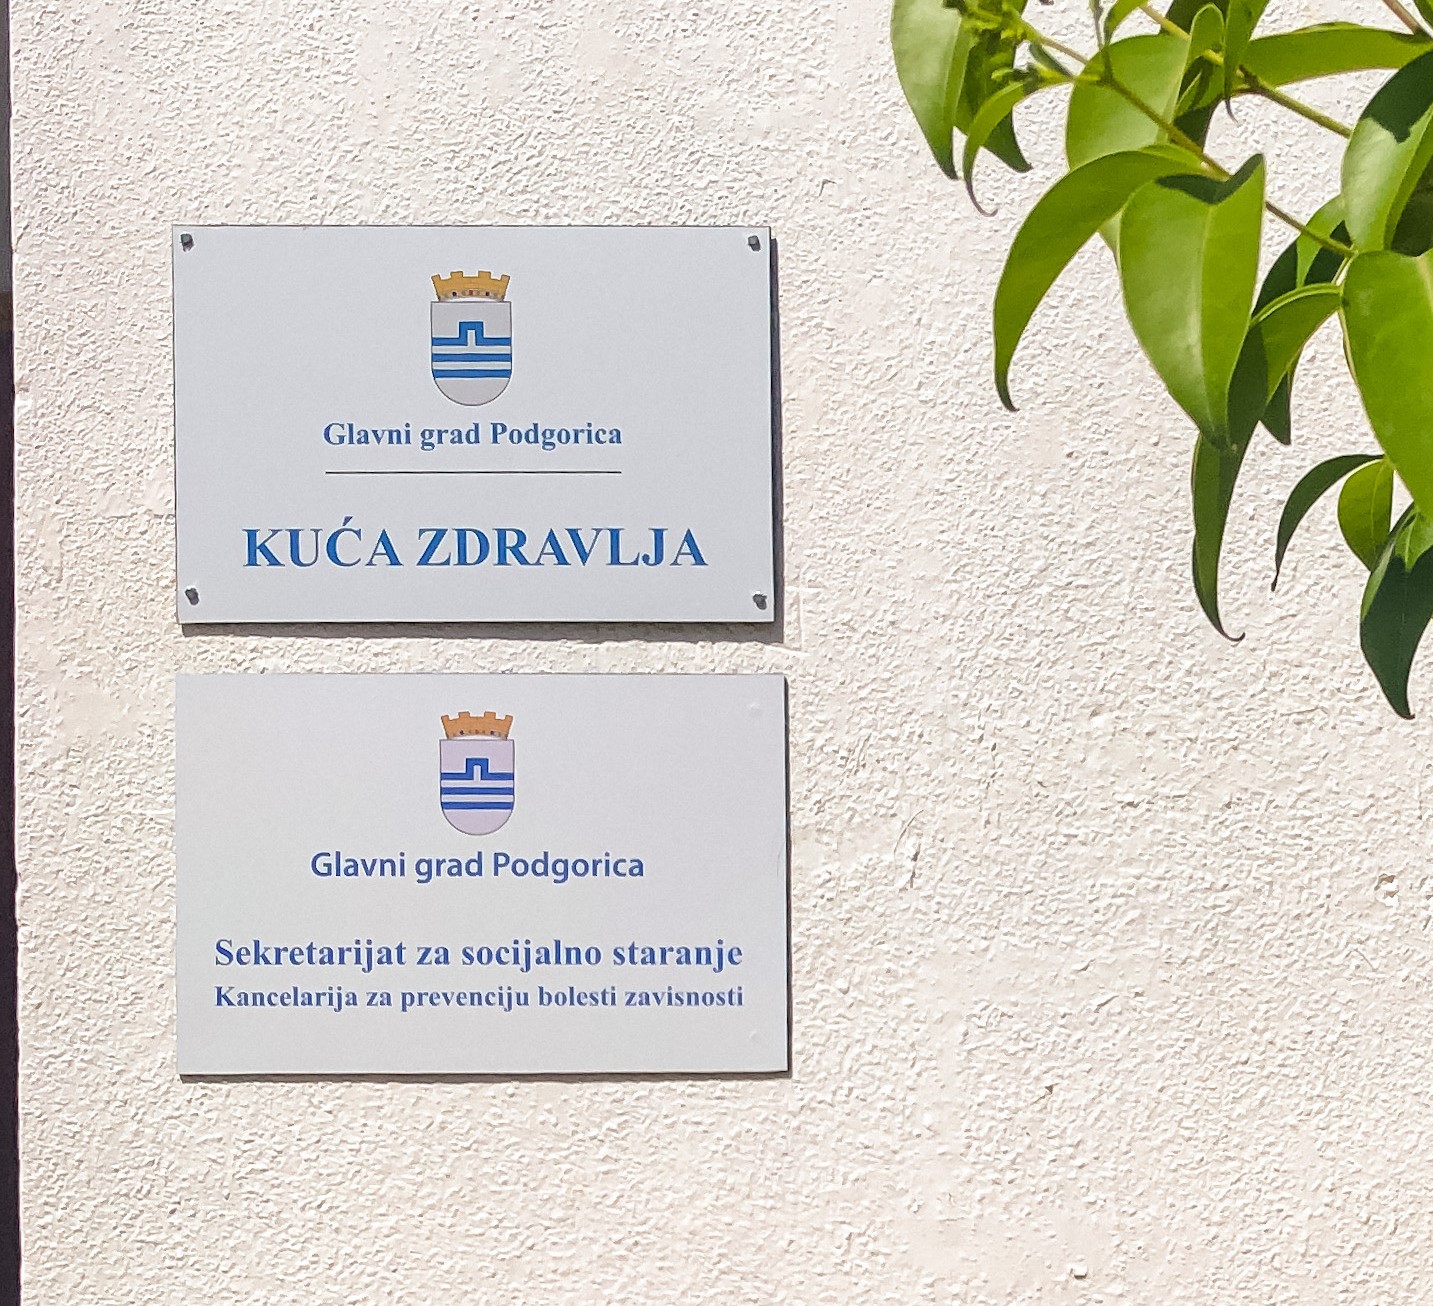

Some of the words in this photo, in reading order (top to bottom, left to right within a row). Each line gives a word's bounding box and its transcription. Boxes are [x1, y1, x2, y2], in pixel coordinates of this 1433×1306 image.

[323, 422, 411, 445] Glavni
[420, 422, 480, 451] grad
[490, 422, 622, 451] Podgorica
[242, 516, 404, 568] KUĆA
[416, 527, 709, 568] ZDRAVLJA
[311, 851, 406, 877] Glavni
[415, 850, 483, 884] grad
[493, 851, 645, 884] Podgorica
[215, 939, 407, 973] Sekretarijat
[416, 946, 451, 966] za
[461, 939, 602, 973] socijalno
[613, 938, 743, 973] staranje
[215, 986, 358, 1012] Kancelarija
[366, 991, 392, 1007] za
[401, 986, 530, 1012] prevenciju
[537, 985, 617, 1007] bolesti
[625, 985, 744, 1007] zavisnosti
